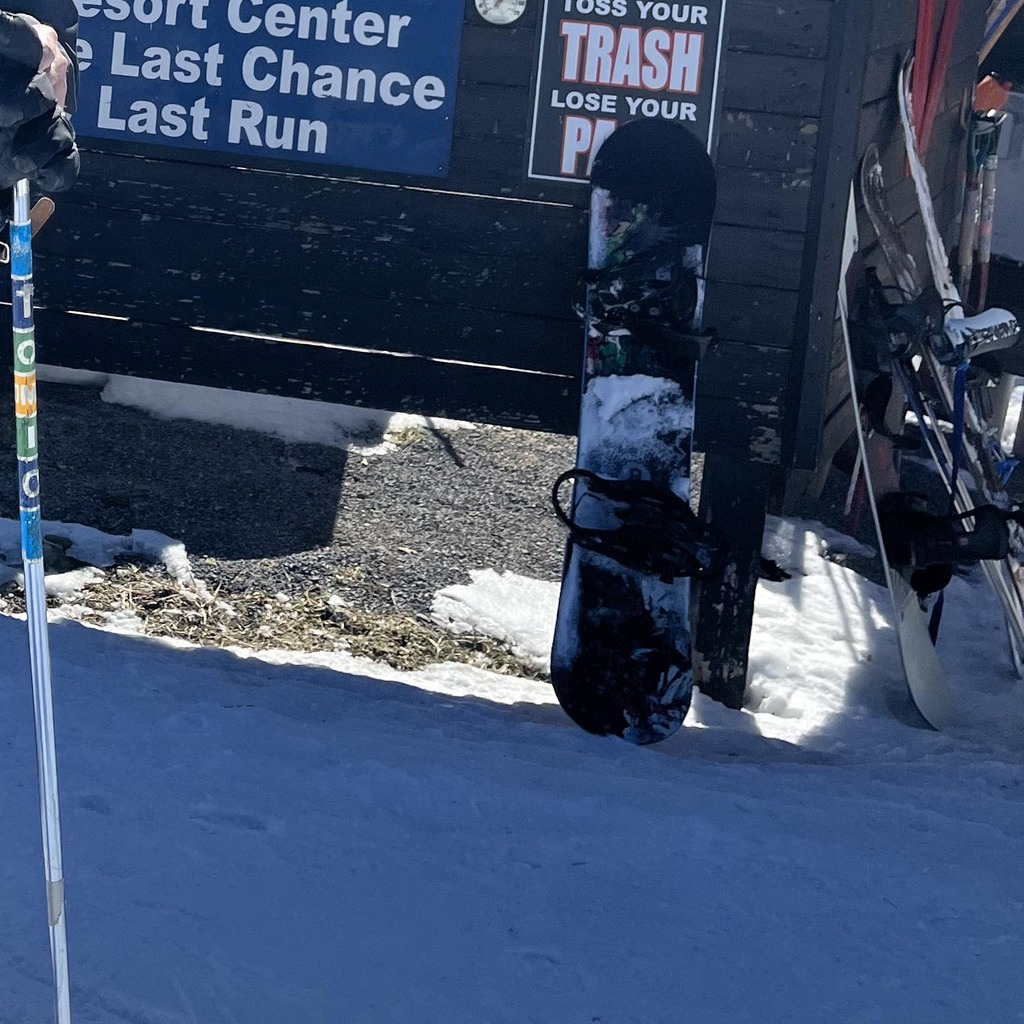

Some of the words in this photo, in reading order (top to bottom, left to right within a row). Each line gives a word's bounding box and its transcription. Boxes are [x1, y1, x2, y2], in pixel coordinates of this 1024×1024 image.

[636, 0, 708, 25] YOUR
[111, 31, 224, 87] Last
[242, 46, 446, 110] Chance
[559, 19, 704, 95] TRASH
[97, 85, 210, 141] Last
[228, 99, 328, 154] Run
[550, 89, 618, 114] LOSE
[626, 96, 698, 122] YOUR
